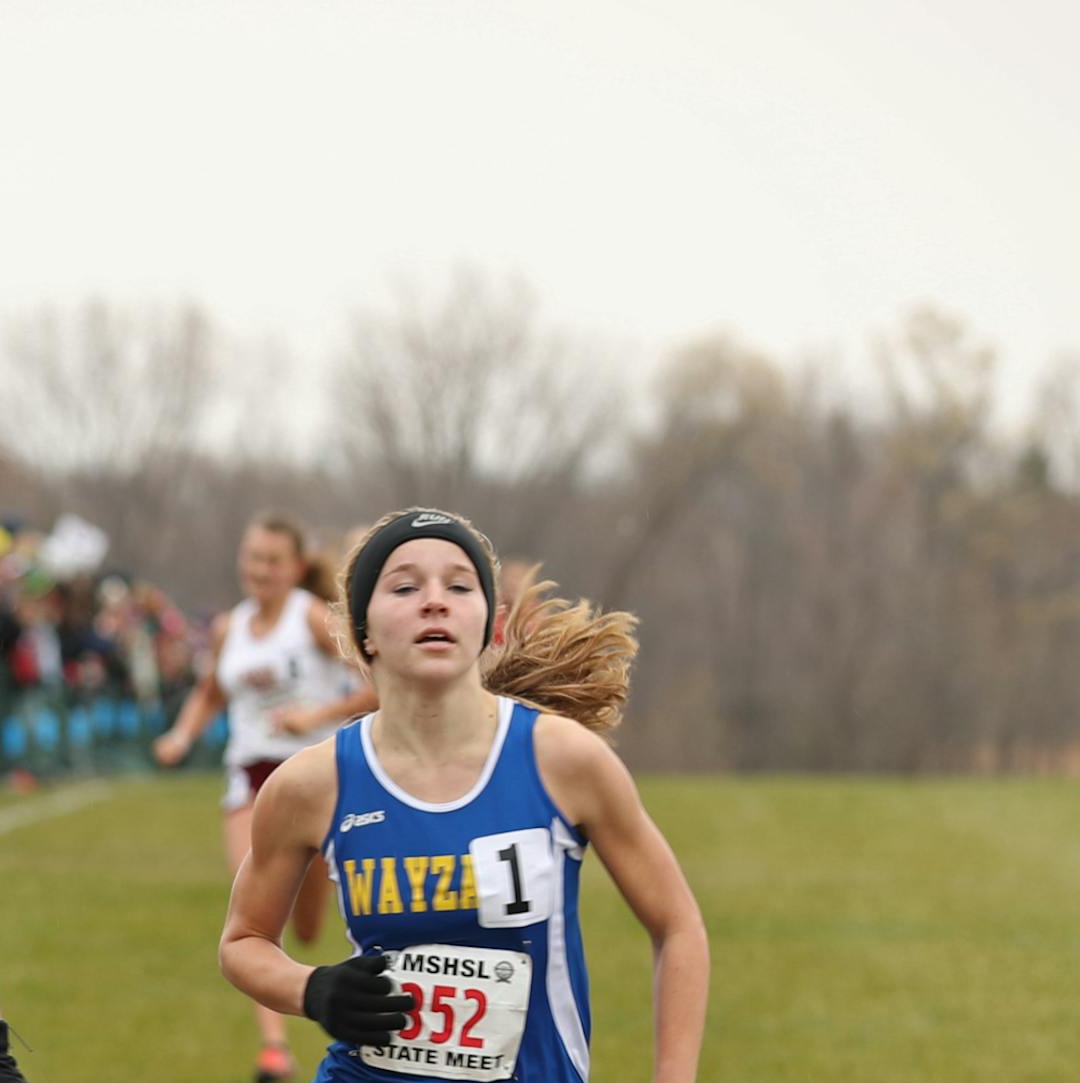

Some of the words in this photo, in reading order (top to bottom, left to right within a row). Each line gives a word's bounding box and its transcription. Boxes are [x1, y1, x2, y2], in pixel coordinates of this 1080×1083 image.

[344, 854, 481, 916] WAYZA
[499, 843, 530, 915] 1
[403, 953, 491, 980] MSHSL
[398, 982, 488, 1048] 352
[373, 1044, 438, 1065] STATE
[446, 1052, 504, 1070] MEET
